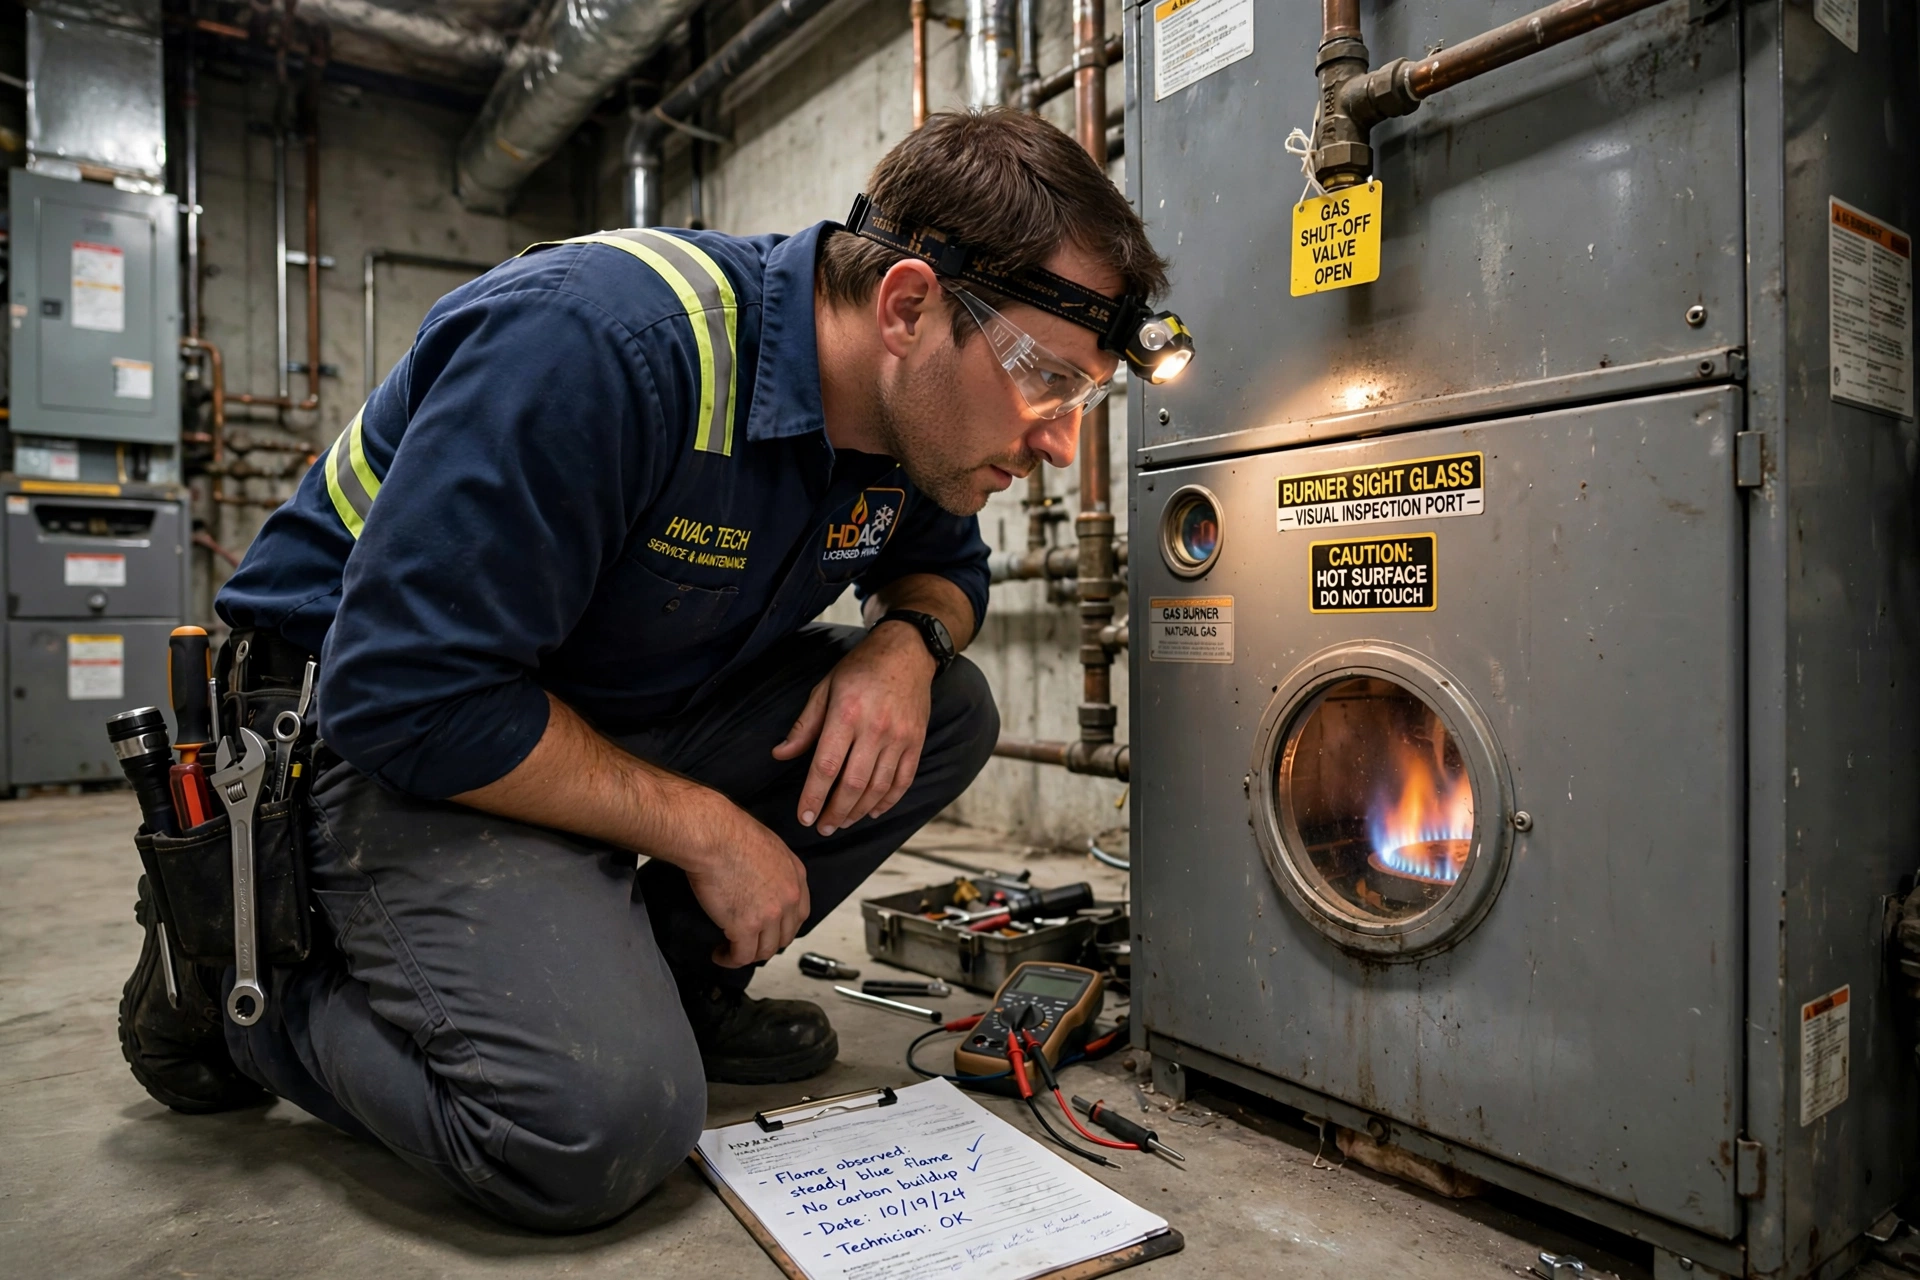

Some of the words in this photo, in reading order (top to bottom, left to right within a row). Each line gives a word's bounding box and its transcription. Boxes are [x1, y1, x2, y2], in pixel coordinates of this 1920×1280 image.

[1321, 198, 1350, 221] GAS
[1301, 213, 1371, 247] SHUT-OFF
[1312, 239, 1356, 264] VALVE
[1314, 261, 1352, 285] OPEN
[1282, 476, 1348, 505] BURNER
[1352, 469, 1404, 498] SIGHT
[1409, 460, 1474, 491] GLASS
[1295, 506, 1339, 526] VISUAL
[1342, 497, 1421, 522] INSPECTION
[1425, 493, 1465, 514] PORT
[665, 516, 713, 545] HVAC
[715, 526, 751, 551] TECH
[826, 523, 882, 549] HDAC
[647, 538, 689, 560] SERVICE
[1329, 542, 1413, 567] CAUTION:
[1317, 569, 1347, 588] HOT
[1351, 564, 1428, 587] SURFACE
[1320, 589, 1339, 606] DO
[1342, 589, 1371, 606] NOT
[1374, 587, 1423, 605] TOUCH
[1163, 607, 1181, 620] GAS
[1182, 607, 1219, 620] BURNER
[1164, 626, 1199, 637] NATURAL
[1200, 626, 1217, 637] GAS
[775, 1166, 828, 1184] Flame
[836, 1145, 911, 1171] observed:
[790, 1177, 847, 1198] steady
[855, 1166, 894, 1182] blue
[904, 1151, 953, 1169] flame
[802, 1201, 828, 1215] No
[837, 1186, 893, 1206] carbon
[896, 1169, 958, 1191] buildup
[818, 1213, 872, 1236] Date:
[879, 1187, 967, 1219] 10/19/24
[835, 1223, 932, 1256] Technician:
[939, 1211, 973, 1229] OK
